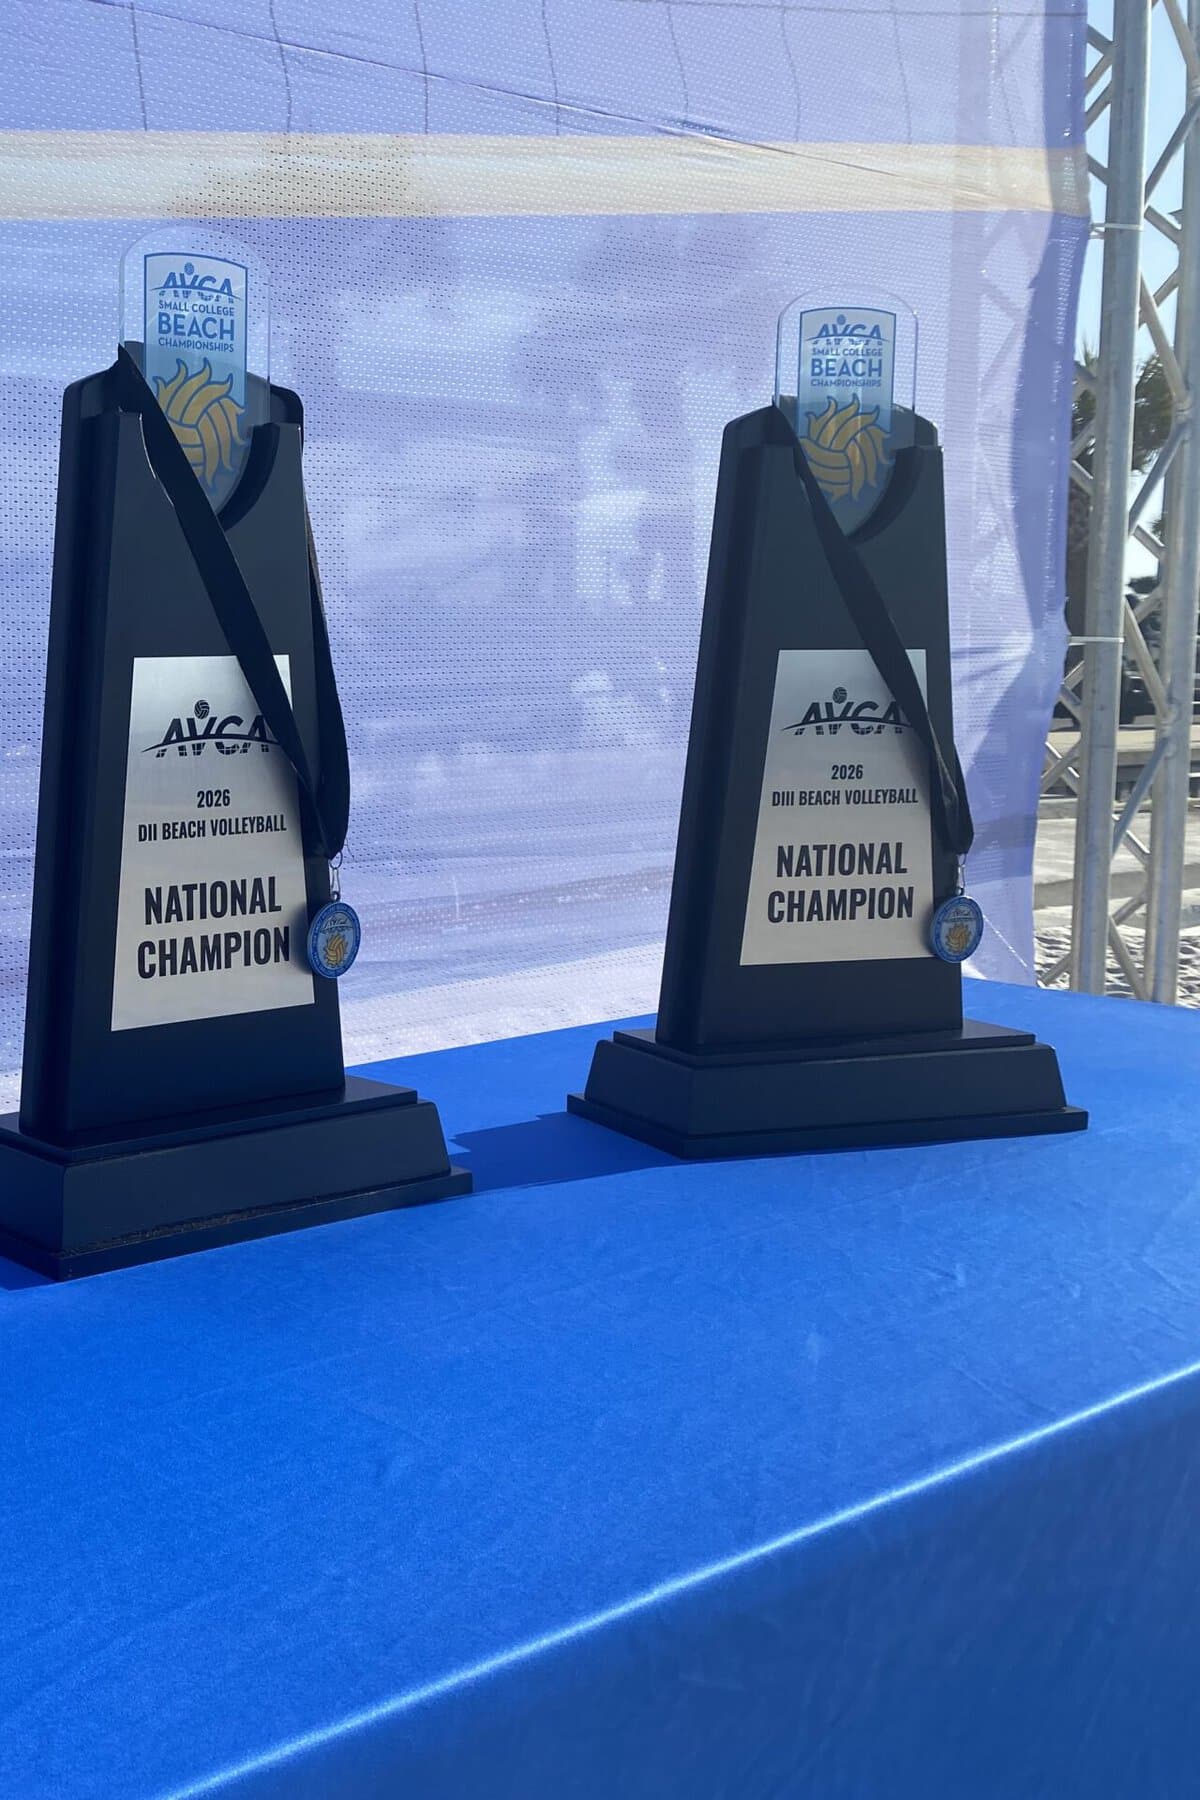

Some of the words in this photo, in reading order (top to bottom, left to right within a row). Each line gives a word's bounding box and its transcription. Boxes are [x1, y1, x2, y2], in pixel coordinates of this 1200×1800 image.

[158, 271, 234, 304] AVCA
[158, 300, 189, 312] SMALL
[192, 303, 235, 317] COLLEGE
[158, 312, 234, 341] BEACH
[812, 323, 882, 346] AVCA
[158, 337, 234, 352] CHAMPIONSHIPS
[812, 347, 840, 356] SMALL
[842, 348, 883, 356] COLLEGE
[811, 358, 882, 377] BEACH
[810, 378, 882, 387] CHAMPIONSHIPS
[794, 700, 903, 736] AVCA
[155, 714, 270, 758] AVCA
[831, 764, 864, 780] 2026
[196, 789, 231, 808] 2026
[772, 791, 795, 806] DIII
[799, 790, 840, 806] BEACH
[845, 788, 919, 805] VOLLEYBALL
[138, 823, 157, 842] DII
[162, 820, 206, 841] BEACH
[210, 814, 287, 836] VOLLEYBALL
[776, 842, 908, 877] NATIONAL
[144, 876, 282, 925] NATIONAL
[767, 886, 914, 923] CHAMPION
[137, 926, 290, 979] CHAMPION
